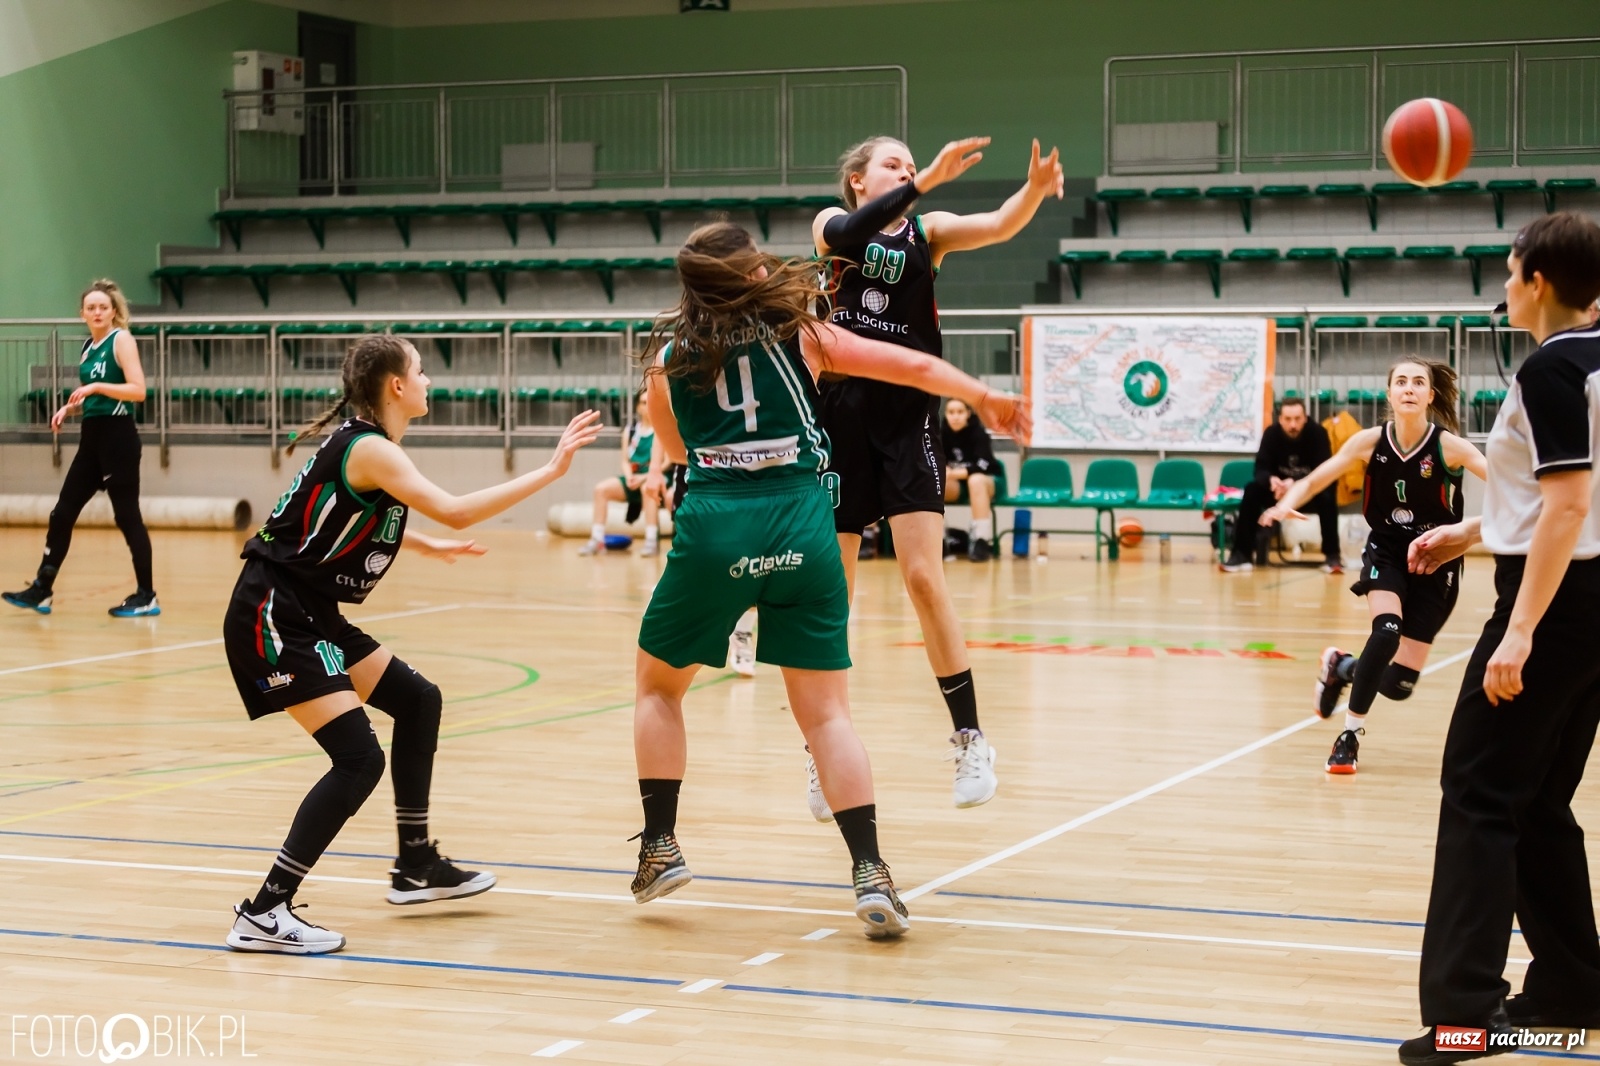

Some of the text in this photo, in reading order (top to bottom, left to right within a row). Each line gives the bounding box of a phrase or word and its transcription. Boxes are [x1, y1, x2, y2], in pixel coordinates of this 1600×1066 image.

[862, 242, 906, 284] 99
[832, 310, 852, 323] CTL
[90, 361, 107, 379] 24
[714, 355, 761, 433] 4
[924, 432, 932, 450] CTL
[928, 451, 942, 495] LOGISTICS
[1394, 479, 1407, 503] 1
[749, 549, 804, 575] Clavis
[335, 573, 358, 587] CTL
[314, 640, 349, 676] 16
